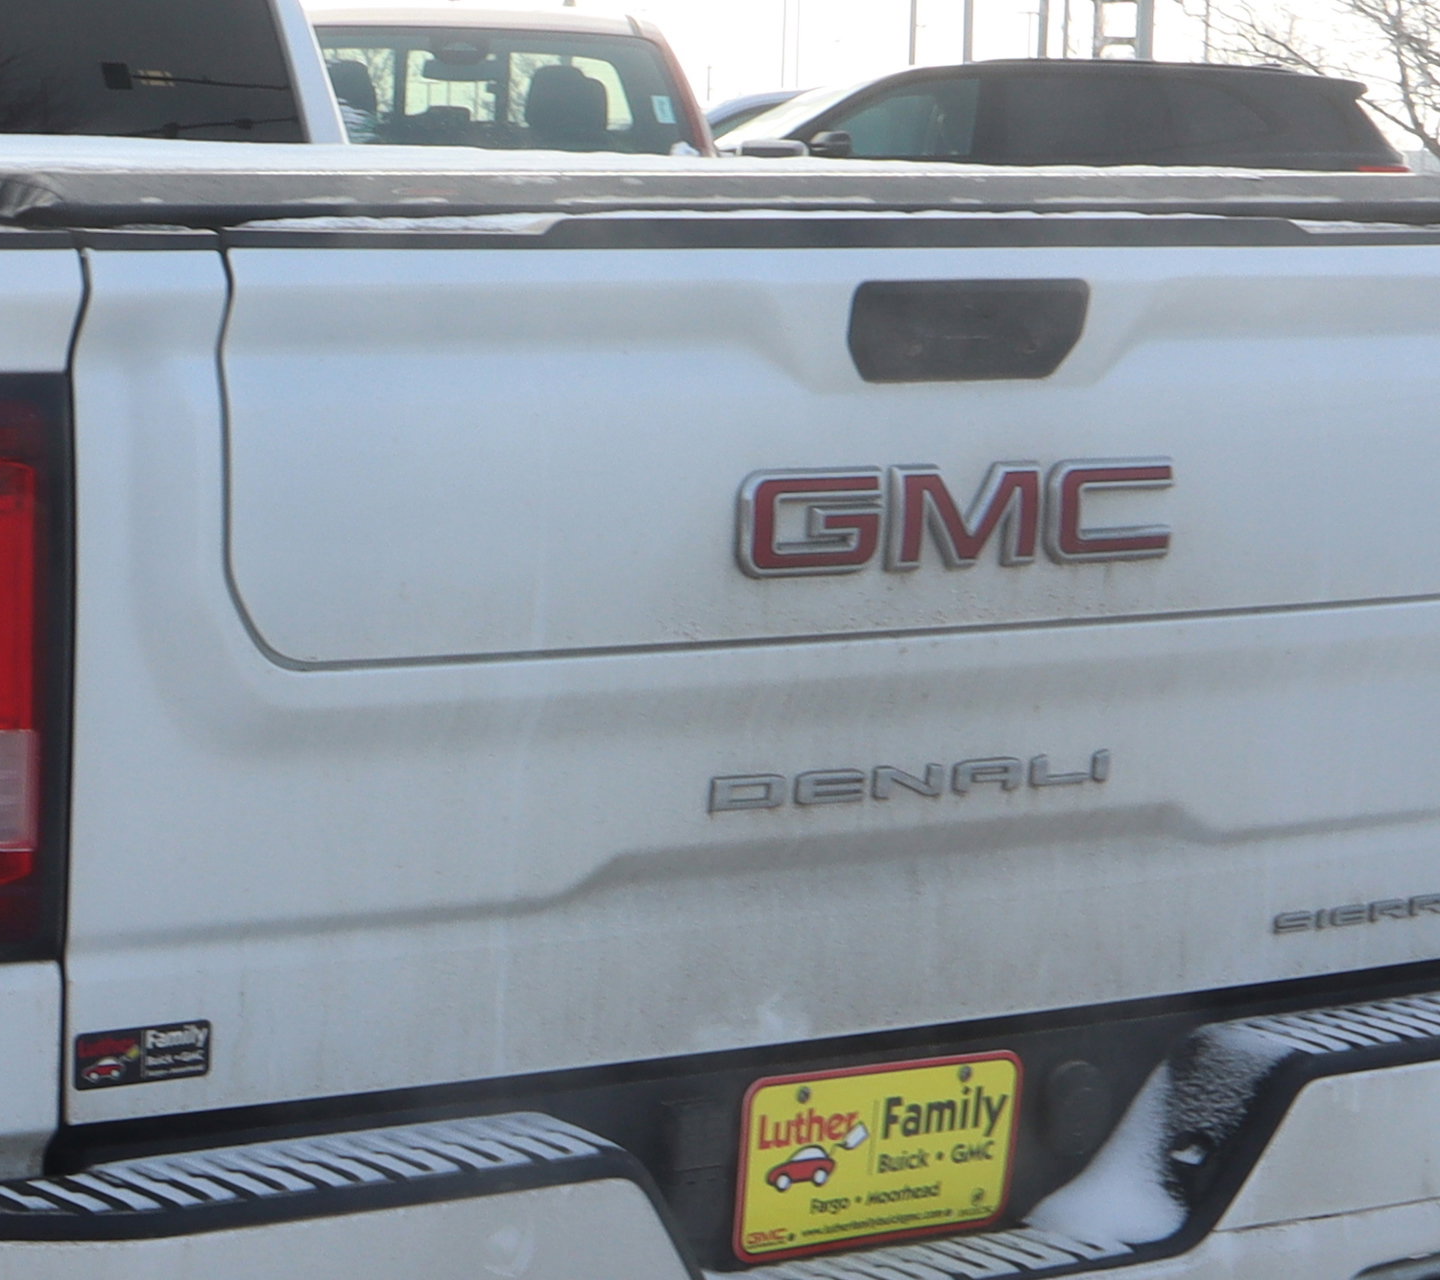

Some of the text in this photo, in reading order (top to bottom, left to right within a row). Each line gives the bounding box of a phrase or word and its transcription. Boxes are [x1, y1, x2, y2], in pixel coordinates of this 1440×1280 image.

[735, 455, 1175, 579] GMC
[707, 748, 1110, 815] DENALI
[145, 1024, 209, 1049] Family
[759, 1110, 859, 1149] Luther
[883, 1087, 1008, 1138] Family
[877, 1141, 995, 1174] Buick GMC
[810, 1183, 941, 1215] Fargo Moorhead
